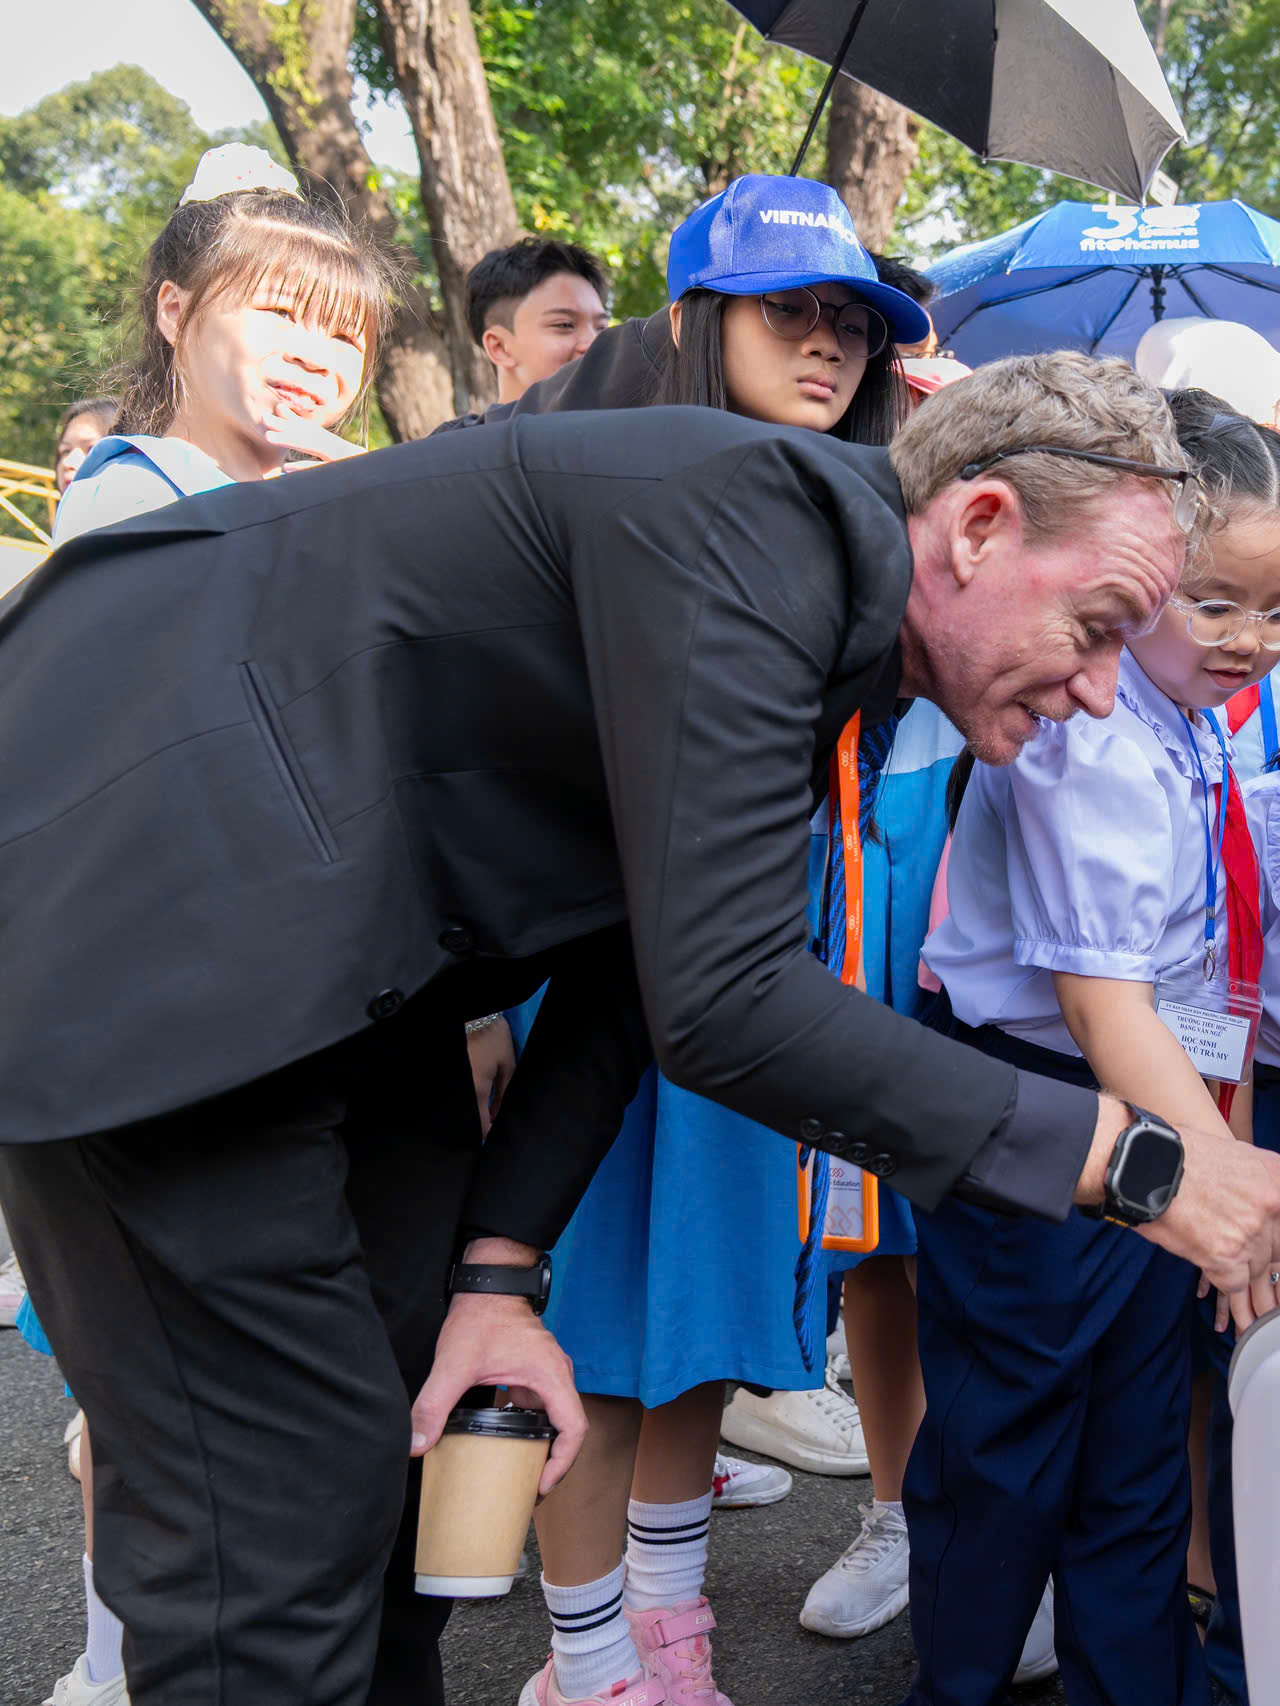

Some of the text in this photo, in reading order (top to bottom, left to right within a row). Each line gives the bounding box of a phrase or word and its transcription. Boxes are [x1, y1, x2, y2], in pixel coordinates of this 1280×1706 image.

[1079, 237, 1200, 251] fit@hcmus
[1197, 1026, 1209, 1035] VĂN
[1181, 1035, 1199, 1045] HỌC
[1199, 1038, 1217, 1049] SINH
[1200, 1047, 1215, 1058] TRÀ
[1216, 1052, 1229, 1061] MY
[832, 1179, 860, 1188] Education
